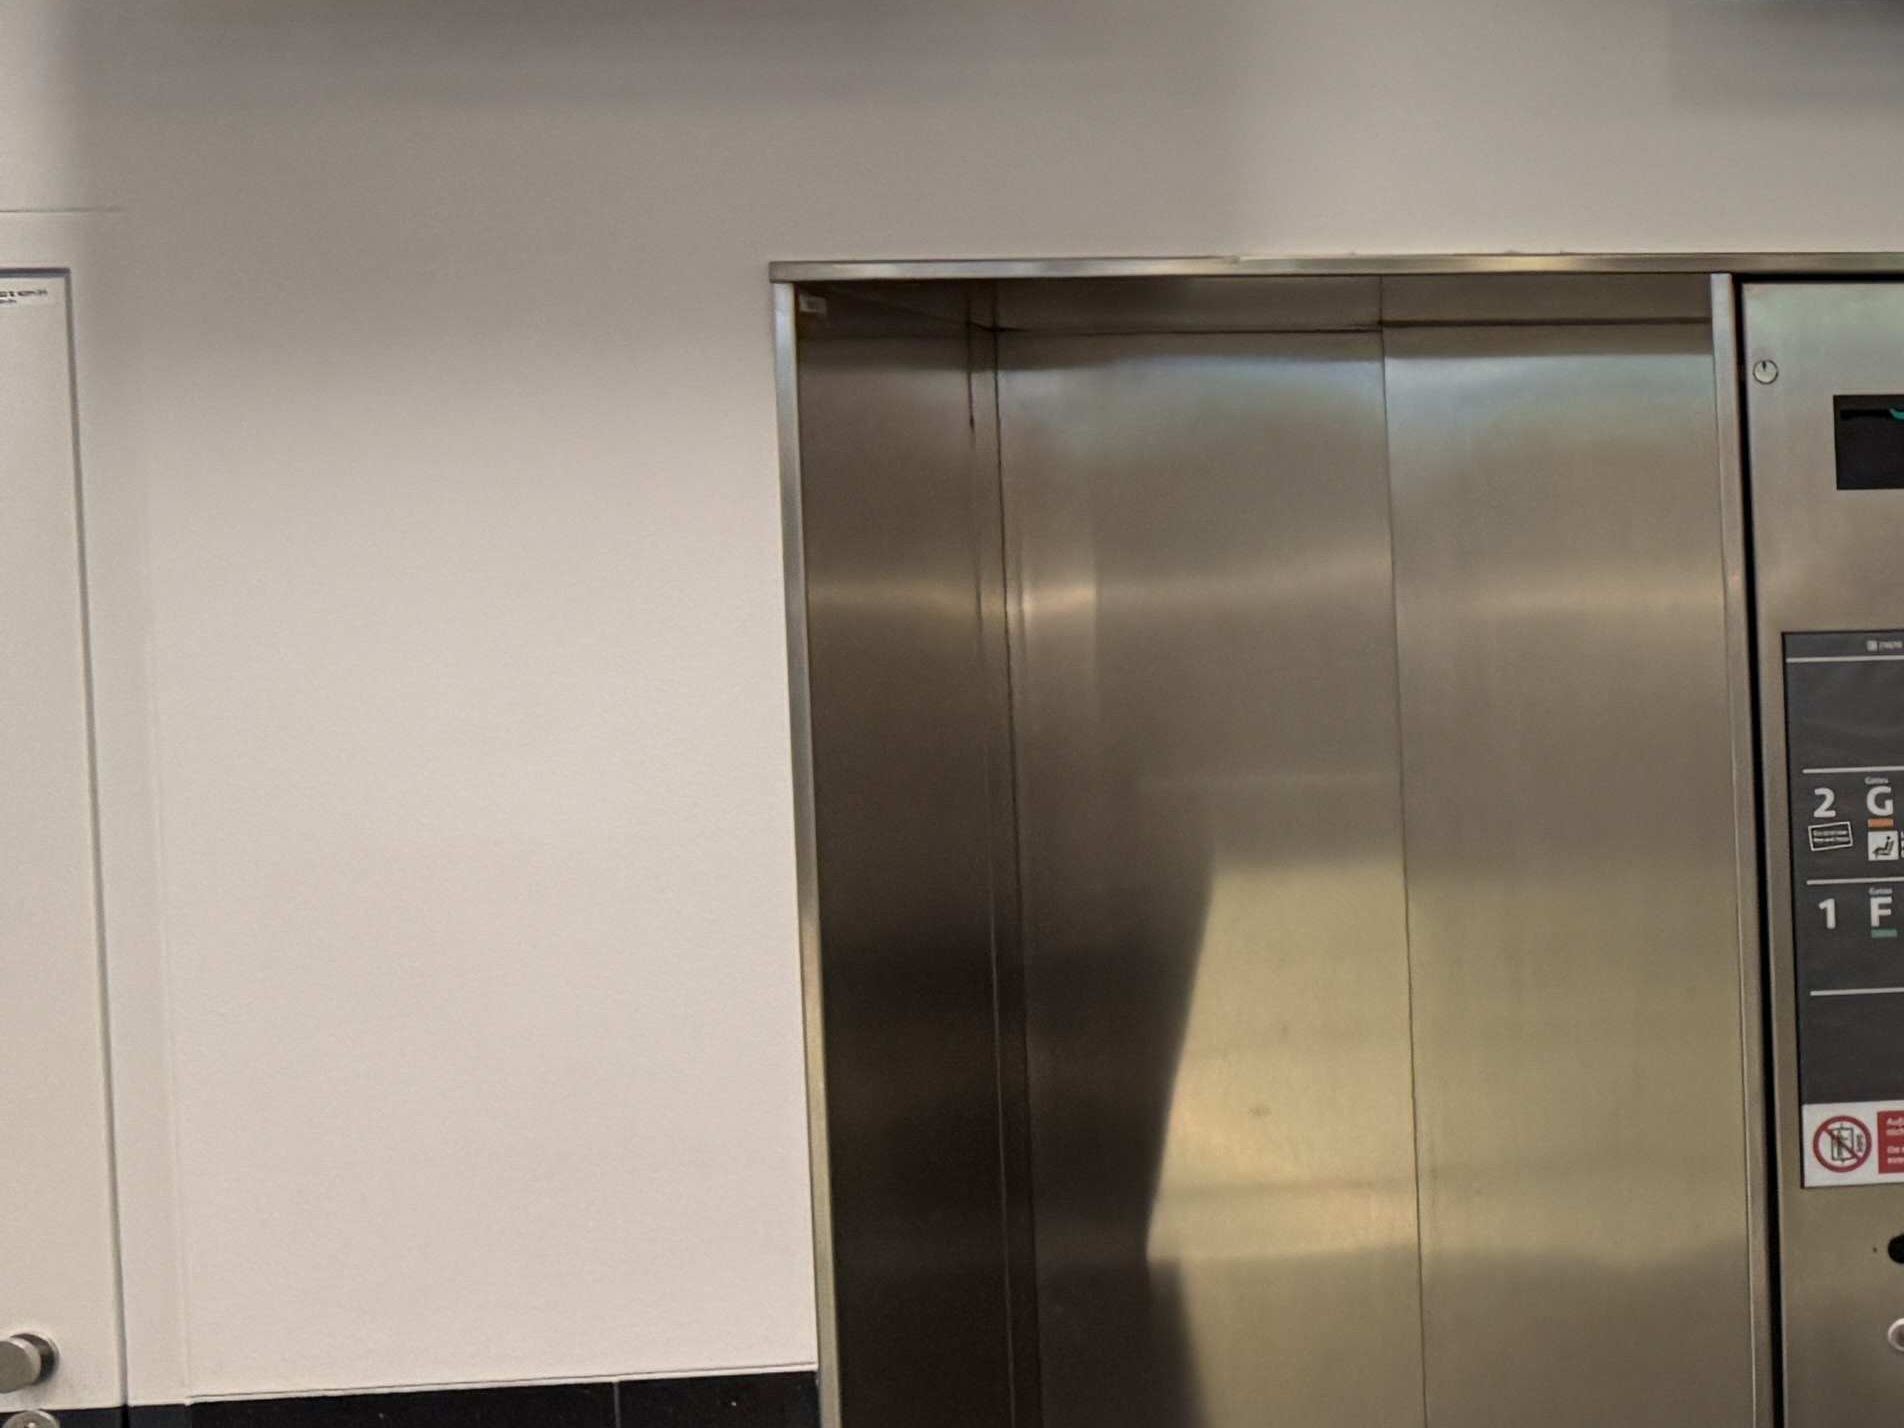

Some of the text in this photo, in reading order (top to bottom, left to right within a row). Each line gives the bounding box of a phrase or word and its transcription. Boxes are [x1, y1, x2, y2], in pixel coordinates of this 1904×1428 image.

[1813, 785, 1894, 818] 2 G
[1818, 895, 1894, 930] 1 F
